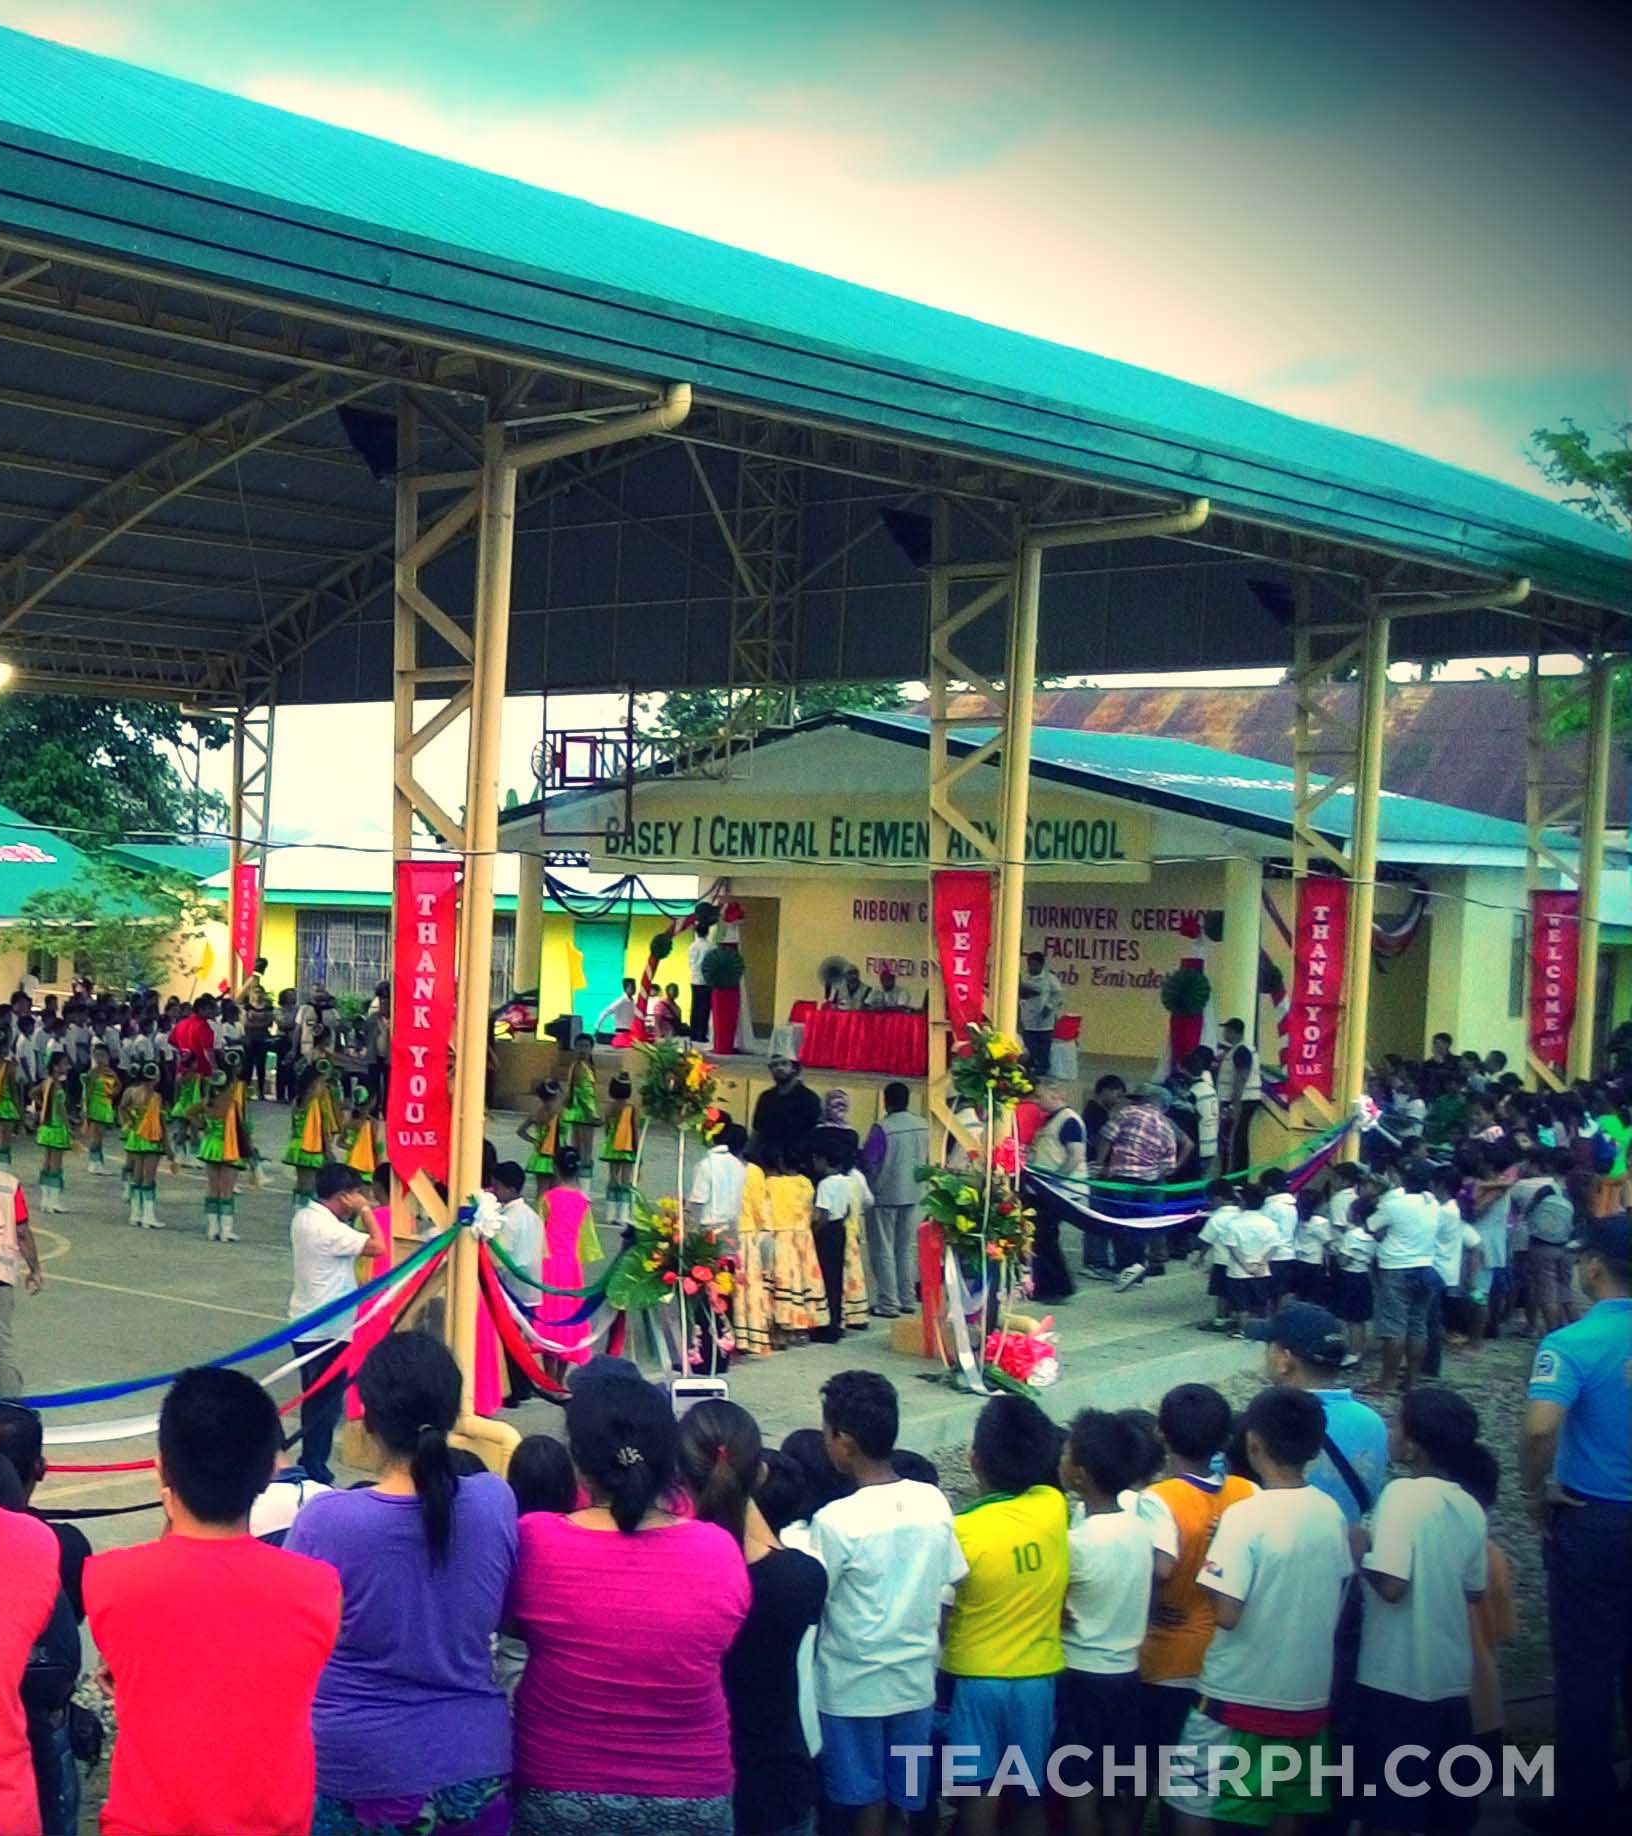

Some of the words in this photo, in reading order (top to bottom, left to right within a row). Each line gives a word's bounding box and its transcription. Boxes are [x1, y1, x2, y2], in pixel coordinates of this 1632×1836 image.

[605, 816, 683, 855] BASEY
[692, 816, 702, 855] I
[710, 816, 819, 857] CENTRAL
[830, 816, 998, 859] ELEMENARY
[853, 900, 909, 922] RIBBON
[1027, 906, 1118, 930] TURNOVER
[412, 893, 439, 1029] THANK
[951, 909, 972, 1001] WELC
[1043, 936, 1140, 961] FACILITIES
[1306, 905, 1330, 995] THANK
[1543, 916, 1563, 1031] WELCOME
[1302, 1007, 1321, 1059] YOU
[405, 1045, 430, 1124] YOU
[398, 1130, 438, 1147] UAE
[1012, 1541, 1042, 1574] 10
